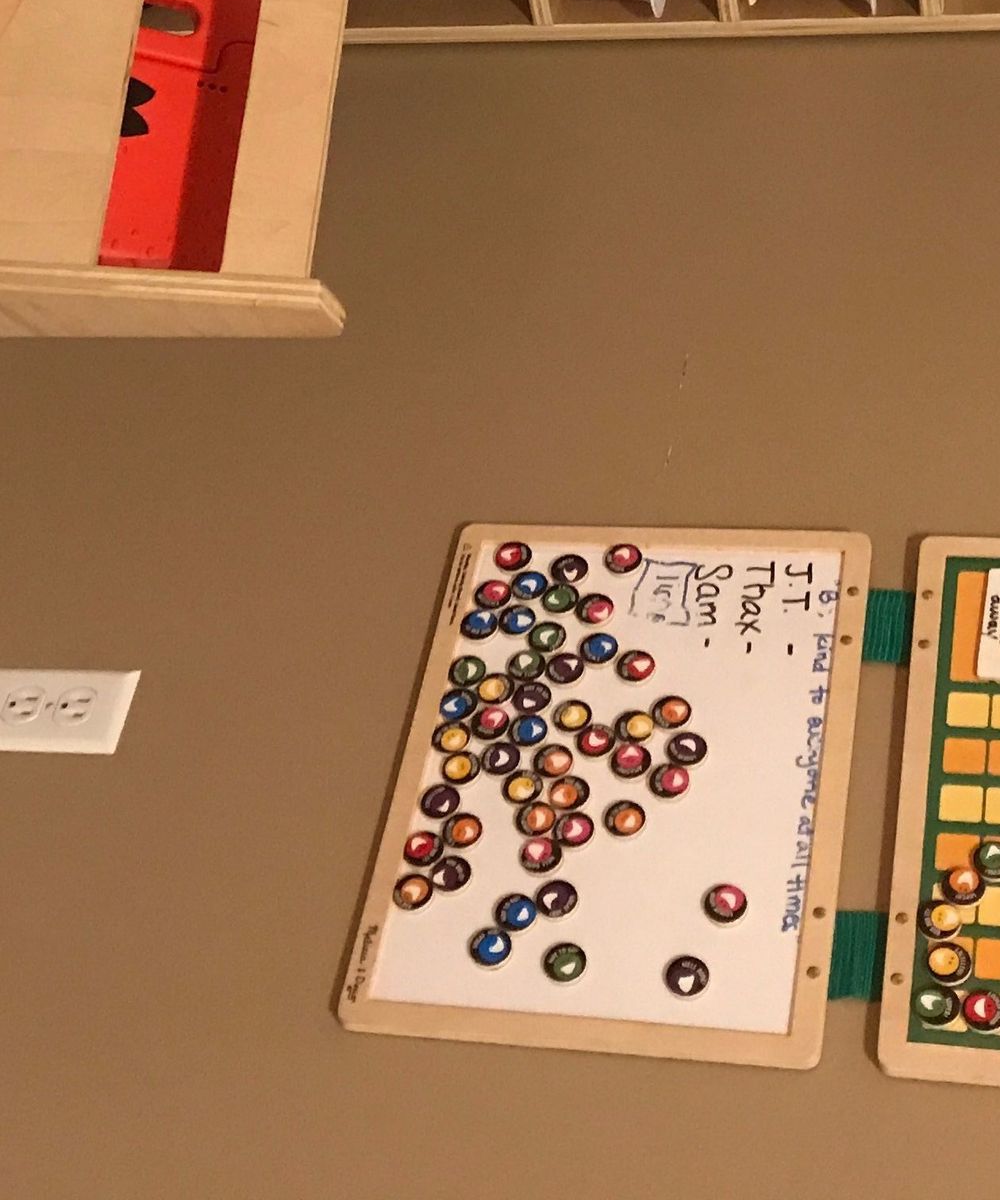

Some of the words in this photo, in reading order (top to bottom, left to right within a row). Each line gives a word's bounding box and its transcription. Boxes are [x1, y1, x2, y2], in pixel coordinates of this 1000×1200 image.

[694, 564, 733, 627] Sam
[782, 562, 813, 613] J.T.
[813, 634, 834, 672] kind
[809, 686, 830, 704] to
[798, 816, 813, 835] at
[792, 841, 812, 867] all
